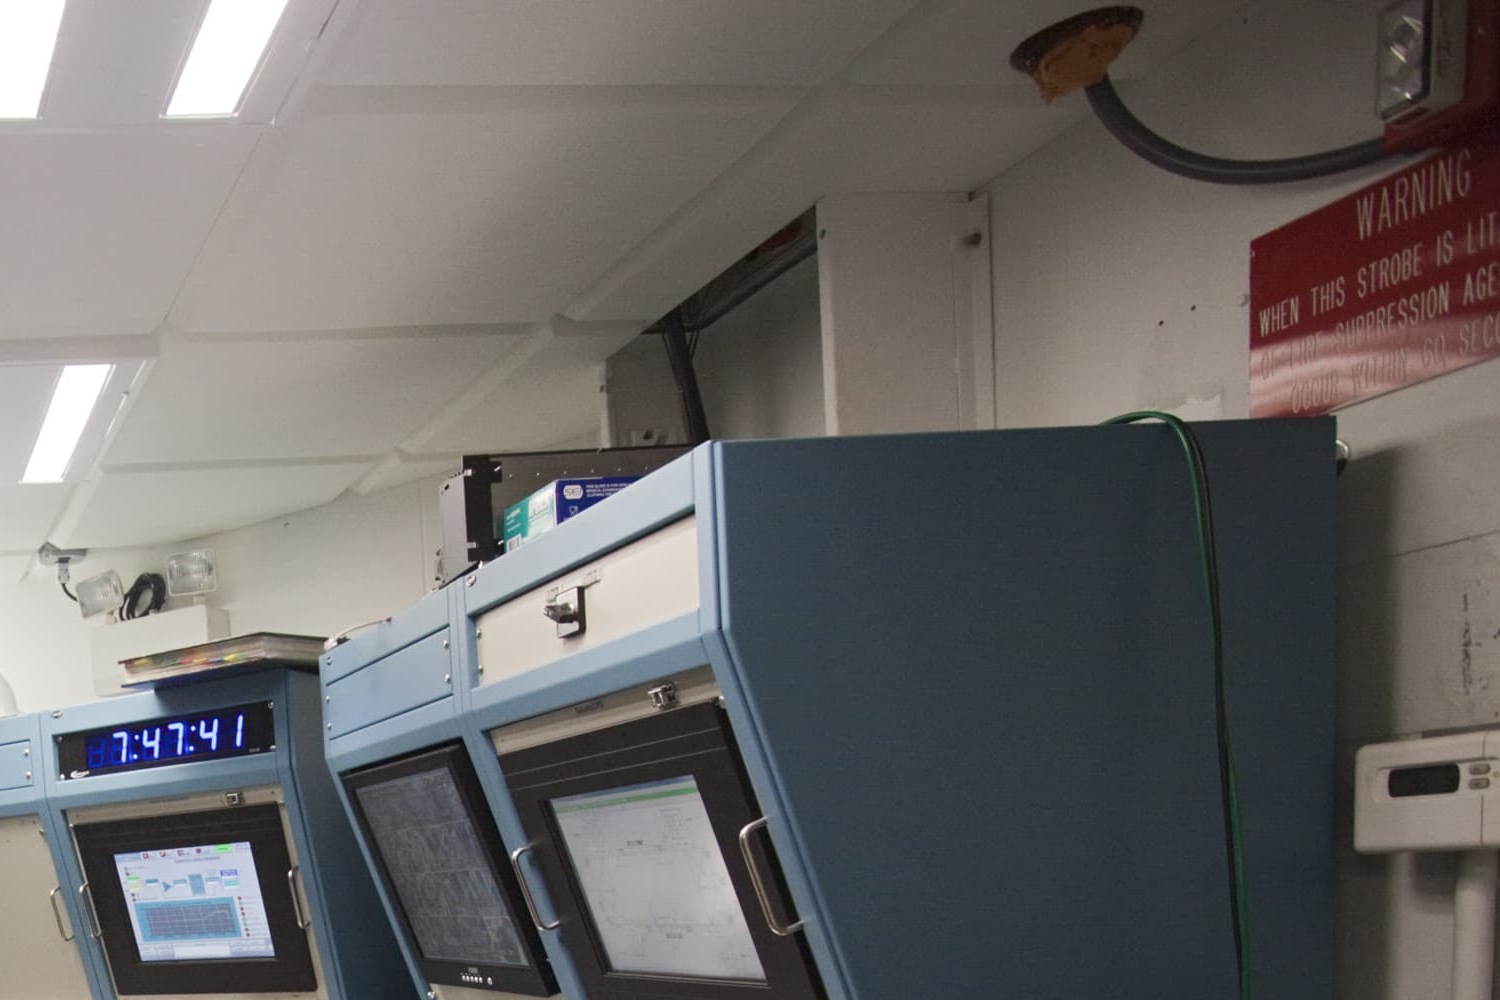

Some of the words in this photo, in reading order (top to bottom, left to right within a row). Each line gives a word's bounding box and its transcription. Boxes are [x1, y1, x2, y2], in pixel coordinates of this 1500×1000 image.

[1356, 149, 1471, 241] WARNING
[1259, 296, 1300, 338] WHEN
[1311, 276, 1346, 317] THIS
[1357, 243, 1423, 298] STROBE
[1436, 230, 1453, 267] IS
[1335, 281, 1450, 351] SUPPRESSION
[1291, 370, 1340, 414] OCCUR
[1352, 348, 1408, 396] WITHIN
[112, 714, 244, 764] 7:47:41
